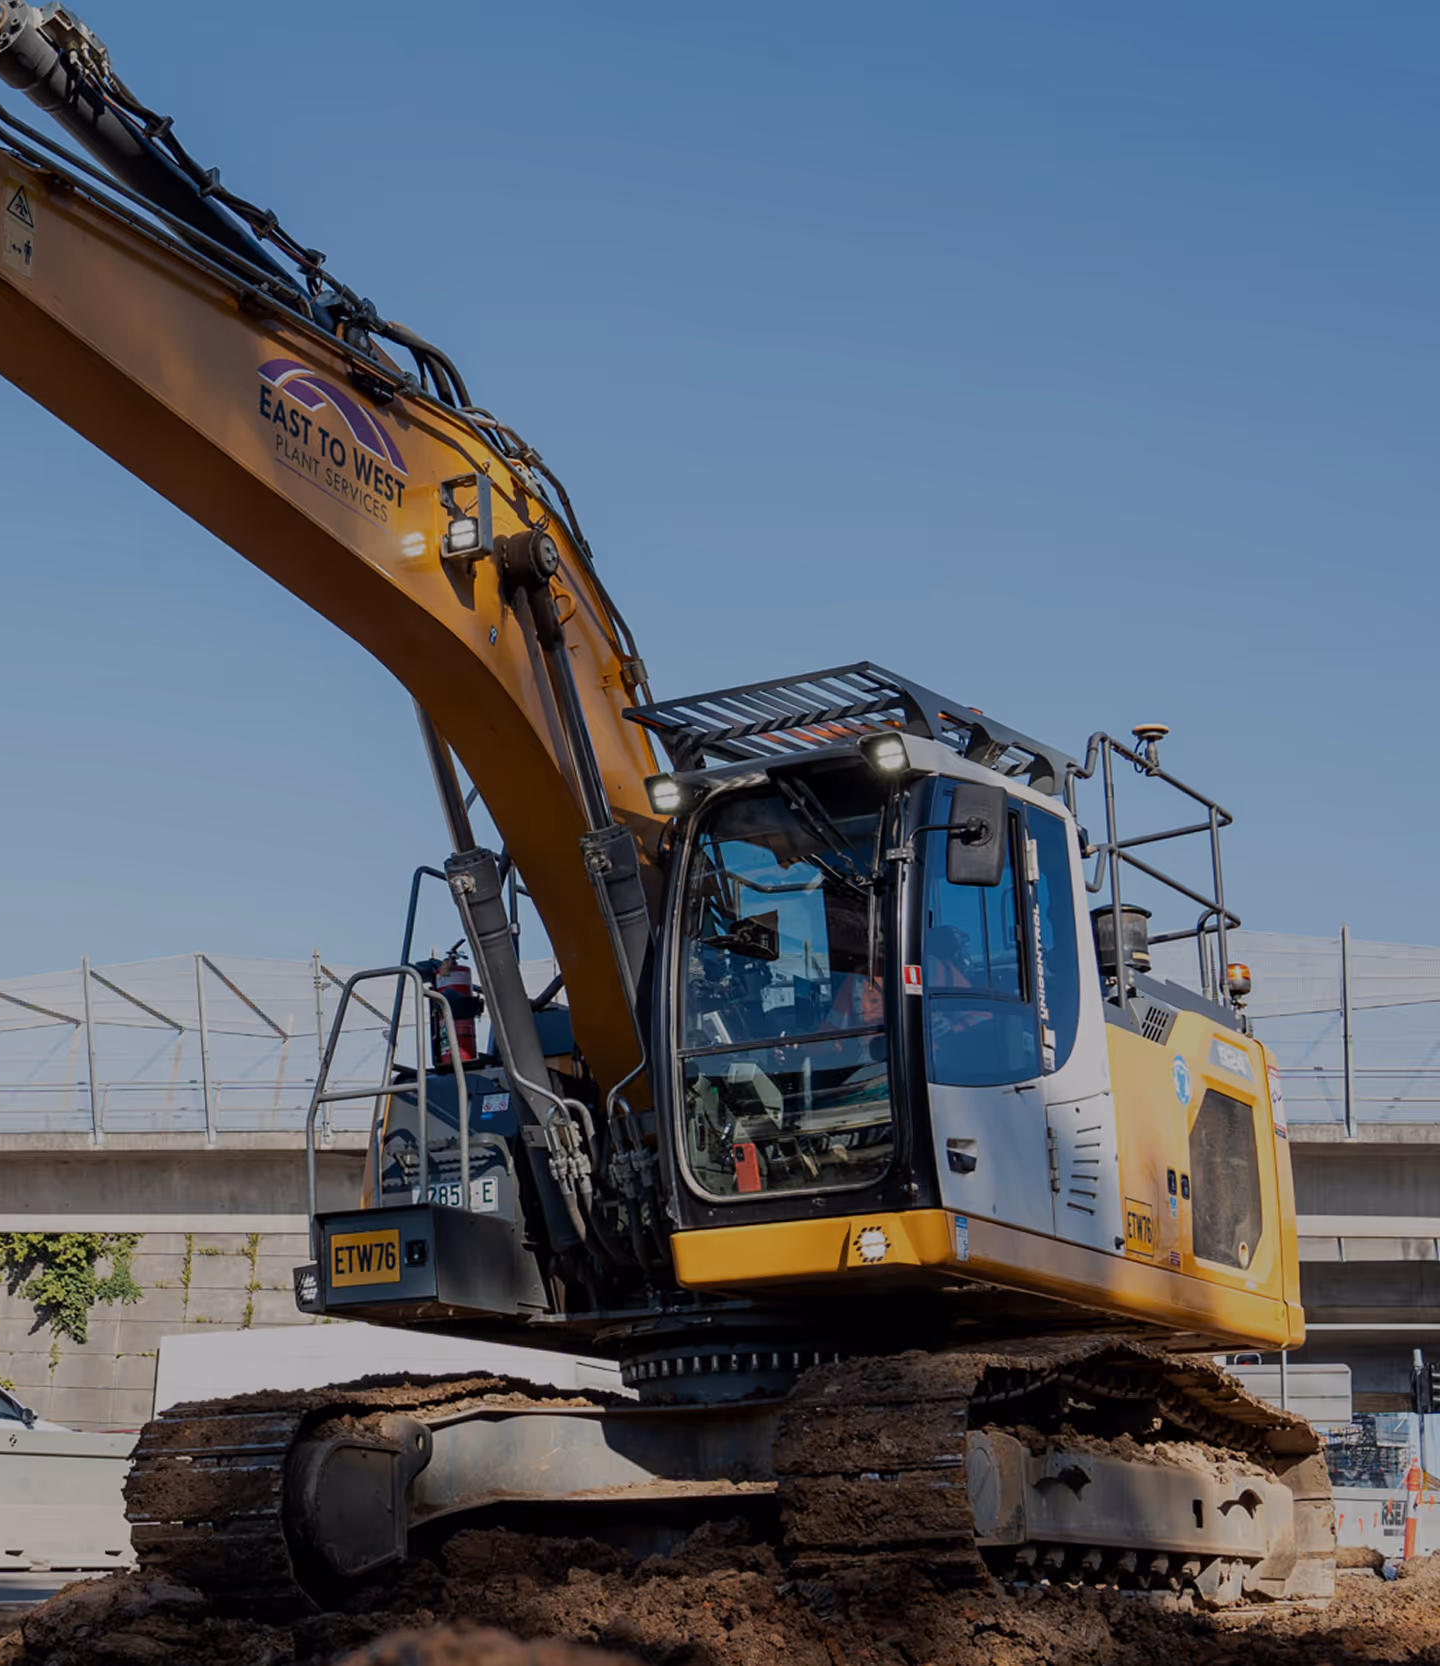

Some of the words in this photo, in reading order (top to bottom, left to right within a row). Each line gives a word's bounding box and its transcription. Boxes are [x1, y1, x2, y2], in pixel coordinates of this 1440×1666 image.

[260, 384, 312, 445] EAST
[318, 426, 346, 468] TO
[353, 447, 406, 507] WEST
[276, 434, 321, 478] PLANT
[325, 467, 388, 522] SERVICES
[1127, 1211, 1152, 1244] ETW76
[335, 1242, 396, 1274] ETW76
